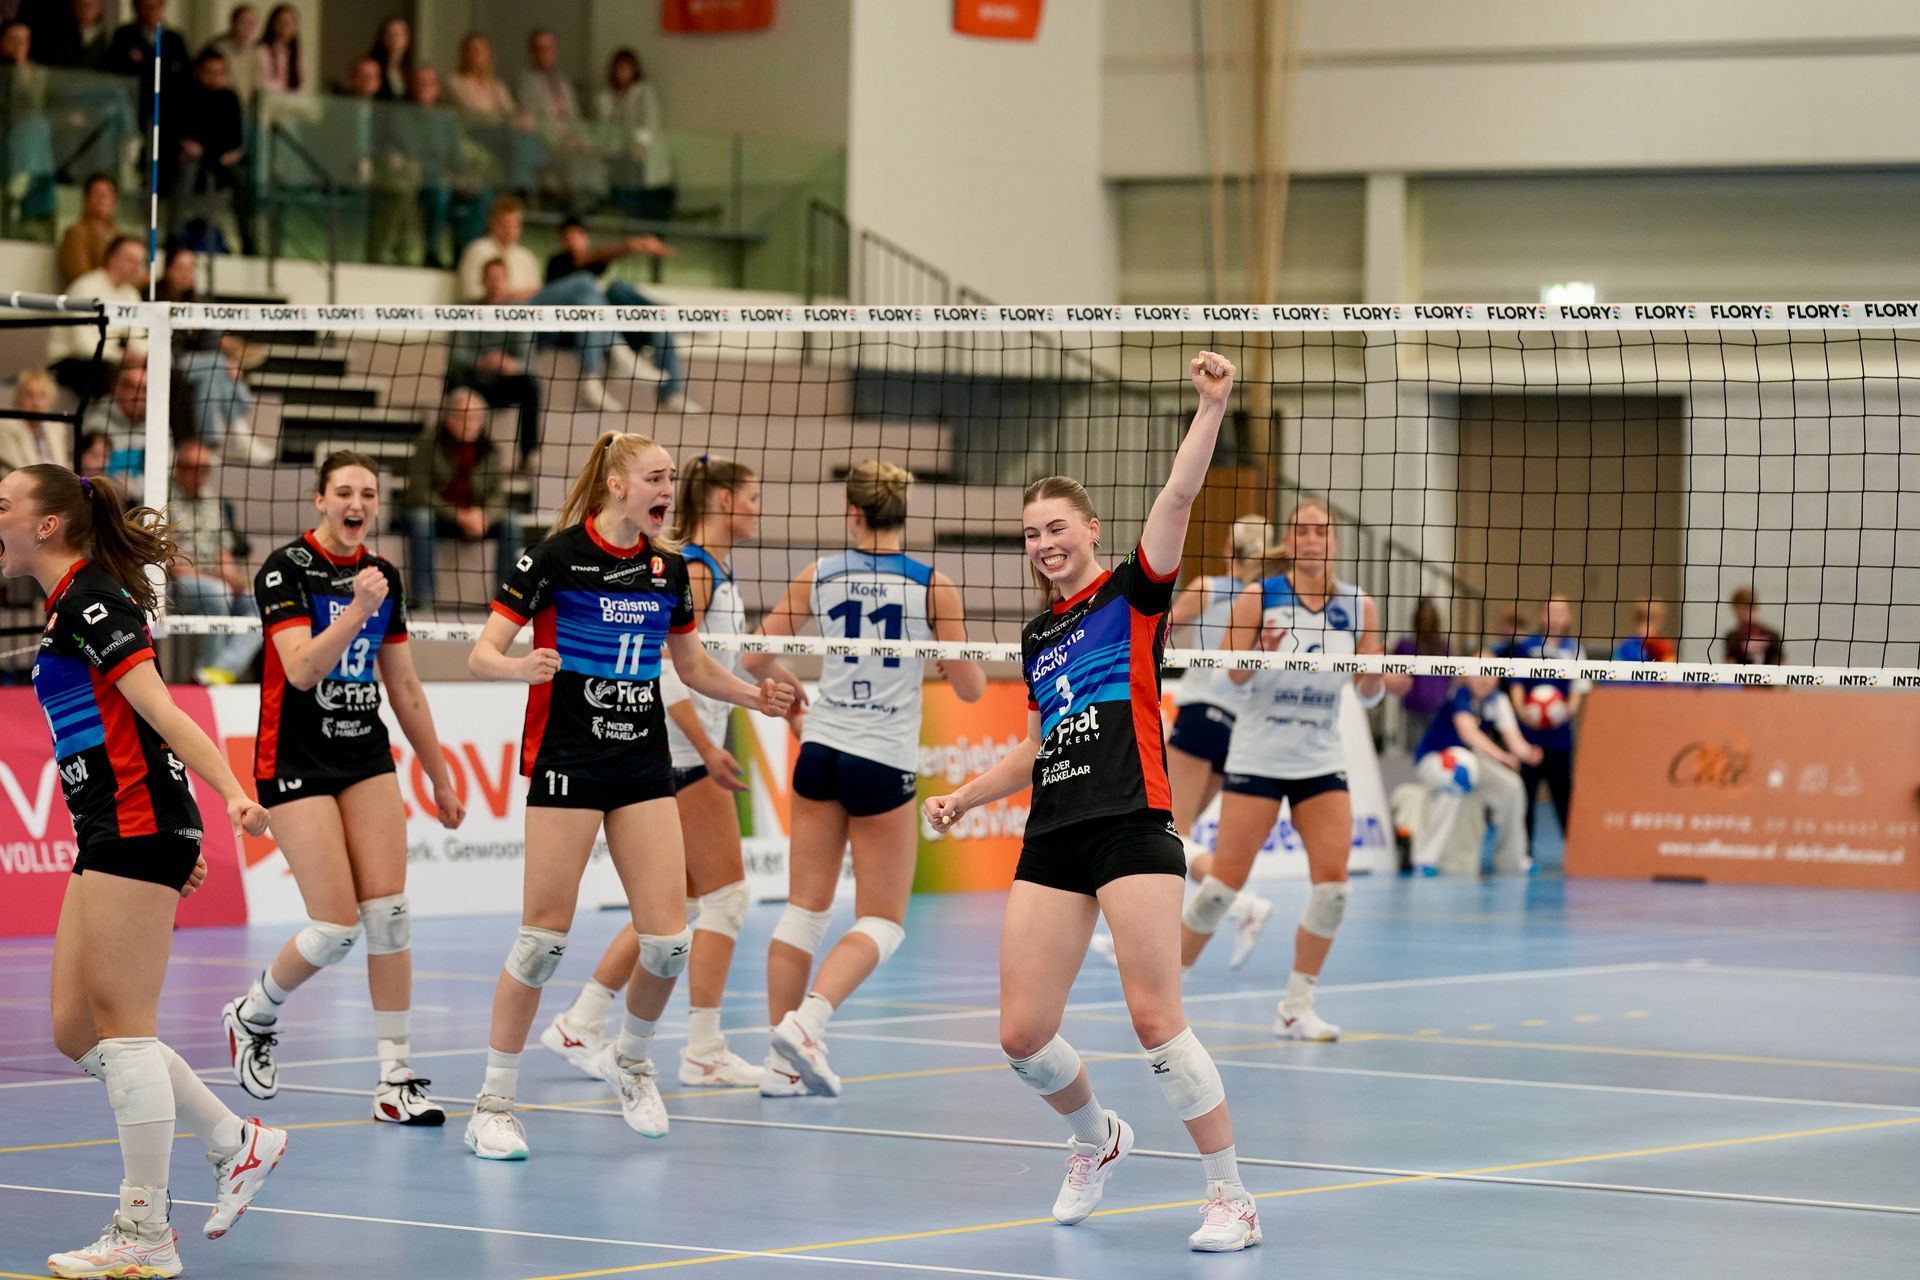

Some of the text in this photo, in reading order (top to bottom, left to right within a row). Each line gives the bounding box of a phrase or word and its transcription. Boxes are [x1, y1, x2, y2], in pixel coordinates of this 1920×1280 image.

[603, 563, 648, 582] MASTERMATE
[850, 582, 888, 598] Koek
[600, 597, 660, 612] Draisma
[602, 609, 645, 624] Bouw
[828, 600, 903, 668] 11
[340, 637, 370, 678] 13
[615, 633, 644, 675] 11
[1055, 674, 1075, 716] 3
[1056, 705, 1099, 744] Fiat
[1057, 732, 1101, 755] BKERY
[545, 770, 569, 796] 11
